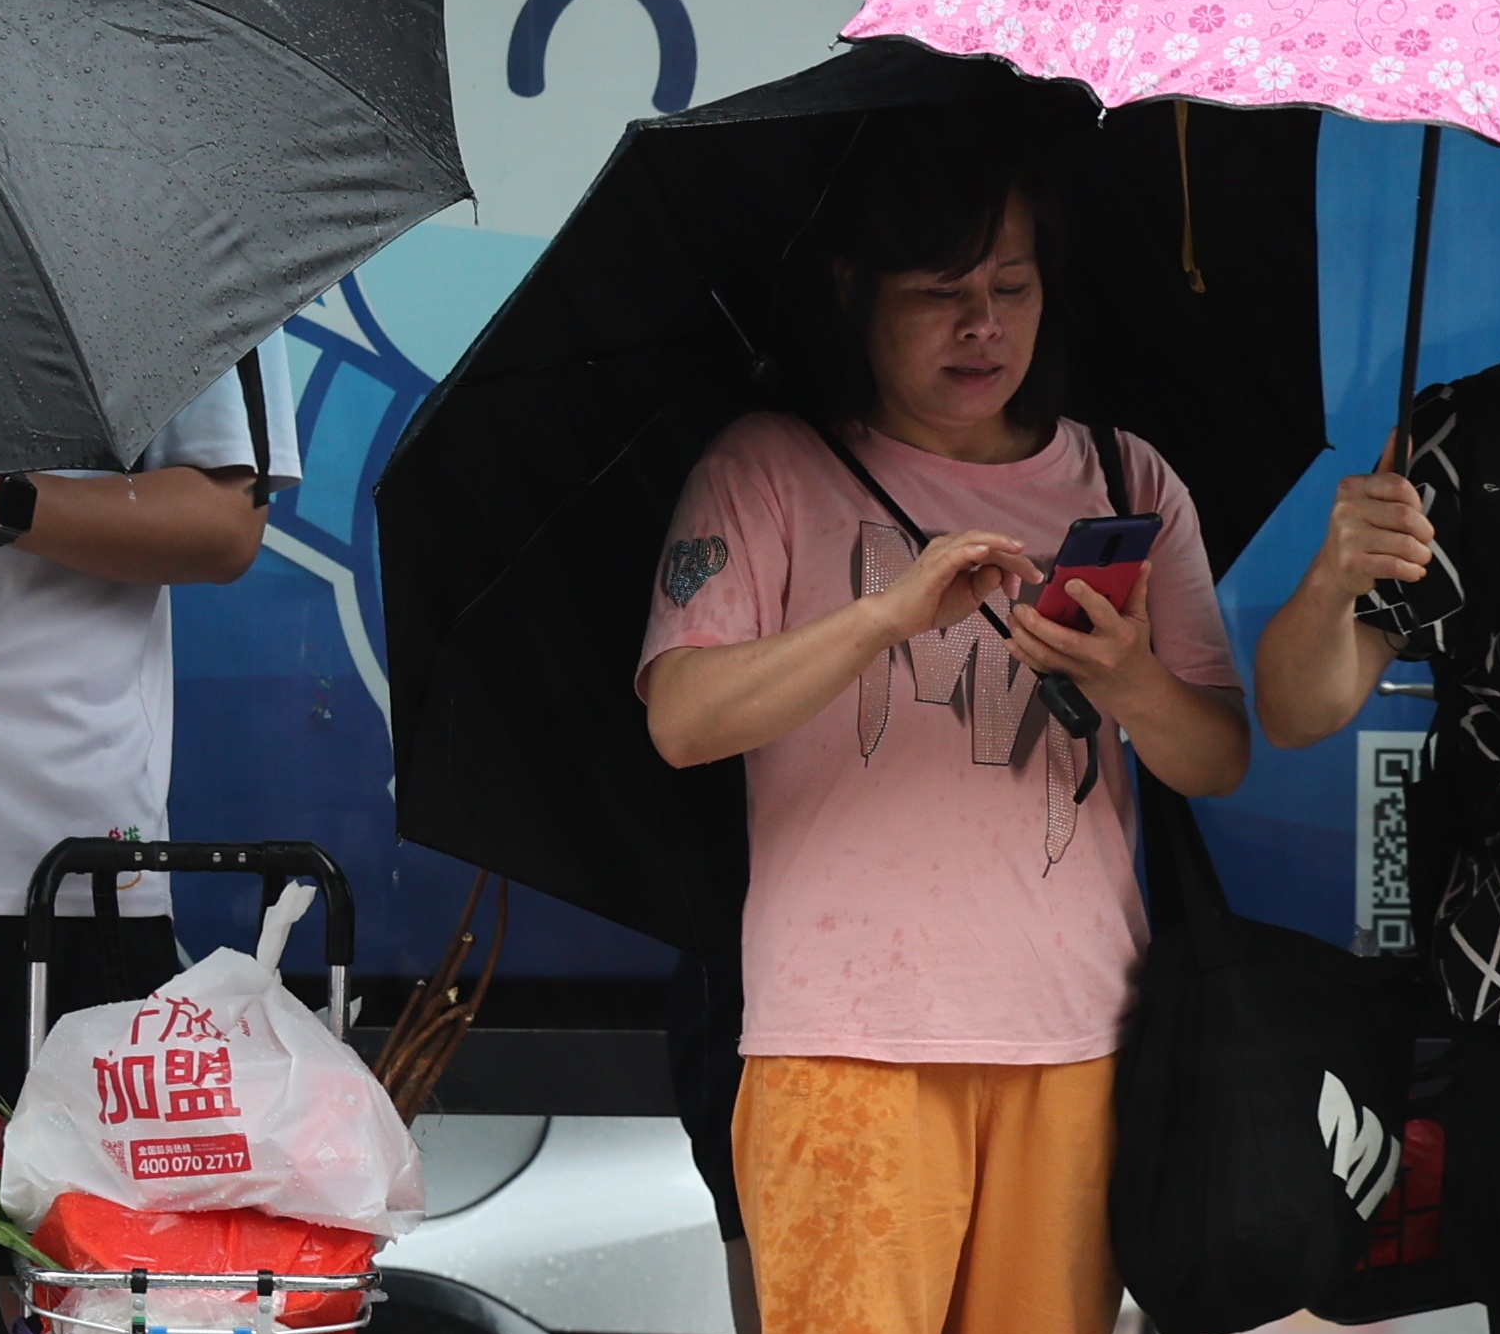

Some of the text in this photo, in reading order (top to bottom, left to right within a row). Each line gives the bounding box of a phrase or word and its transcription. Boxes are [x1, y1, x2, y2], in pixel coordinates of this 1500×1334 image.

[93, 1047, 241, 1124] 加盟
[138, 1152, 245, 1174] 400 070 2717
